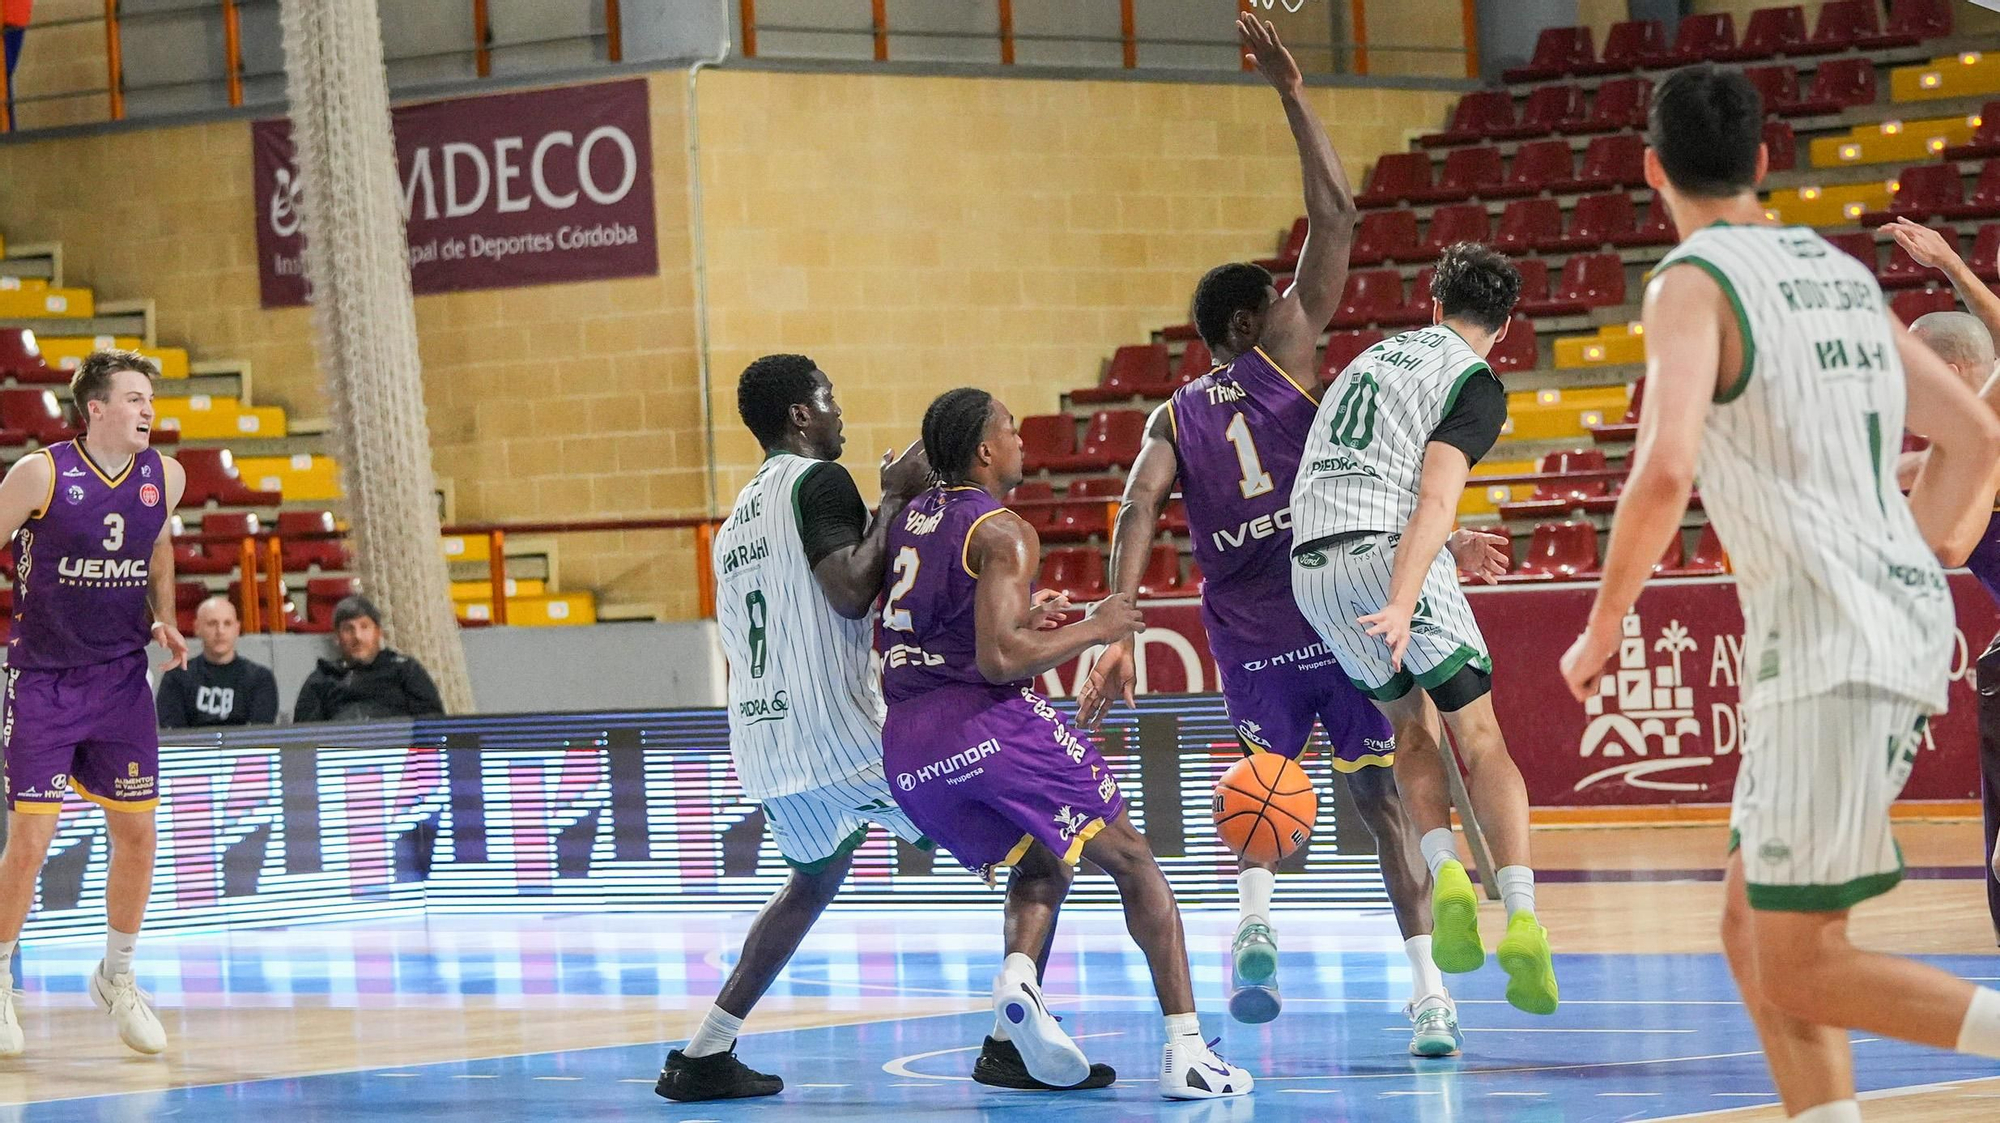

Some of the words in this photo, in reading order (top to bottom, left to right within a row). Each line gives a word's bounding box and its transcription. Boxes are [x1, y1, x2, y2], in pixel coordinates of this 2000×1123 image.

[443, 238, 466, 260] de
[469, 231, 554, 261] Deportes
[556, 222, 639, 251] Córdoba
[1329, 372, 1380, 451] 10
[1225, 411, 1275, 500] 1
[102, 513, 125, 551] 3
[1212, 506, 1292, 552] IVEC
[58, 557, 148, 579] UEMC
[59, 577, 149, 588] UNIVERSIDAD
[882, 545, 920, 633] 2
[1298, 657, 1336, 671] Hyupersa
[916, 738, 1001, 783] HYUNDAI
[946, 766, 984, 786] Hyupersa
